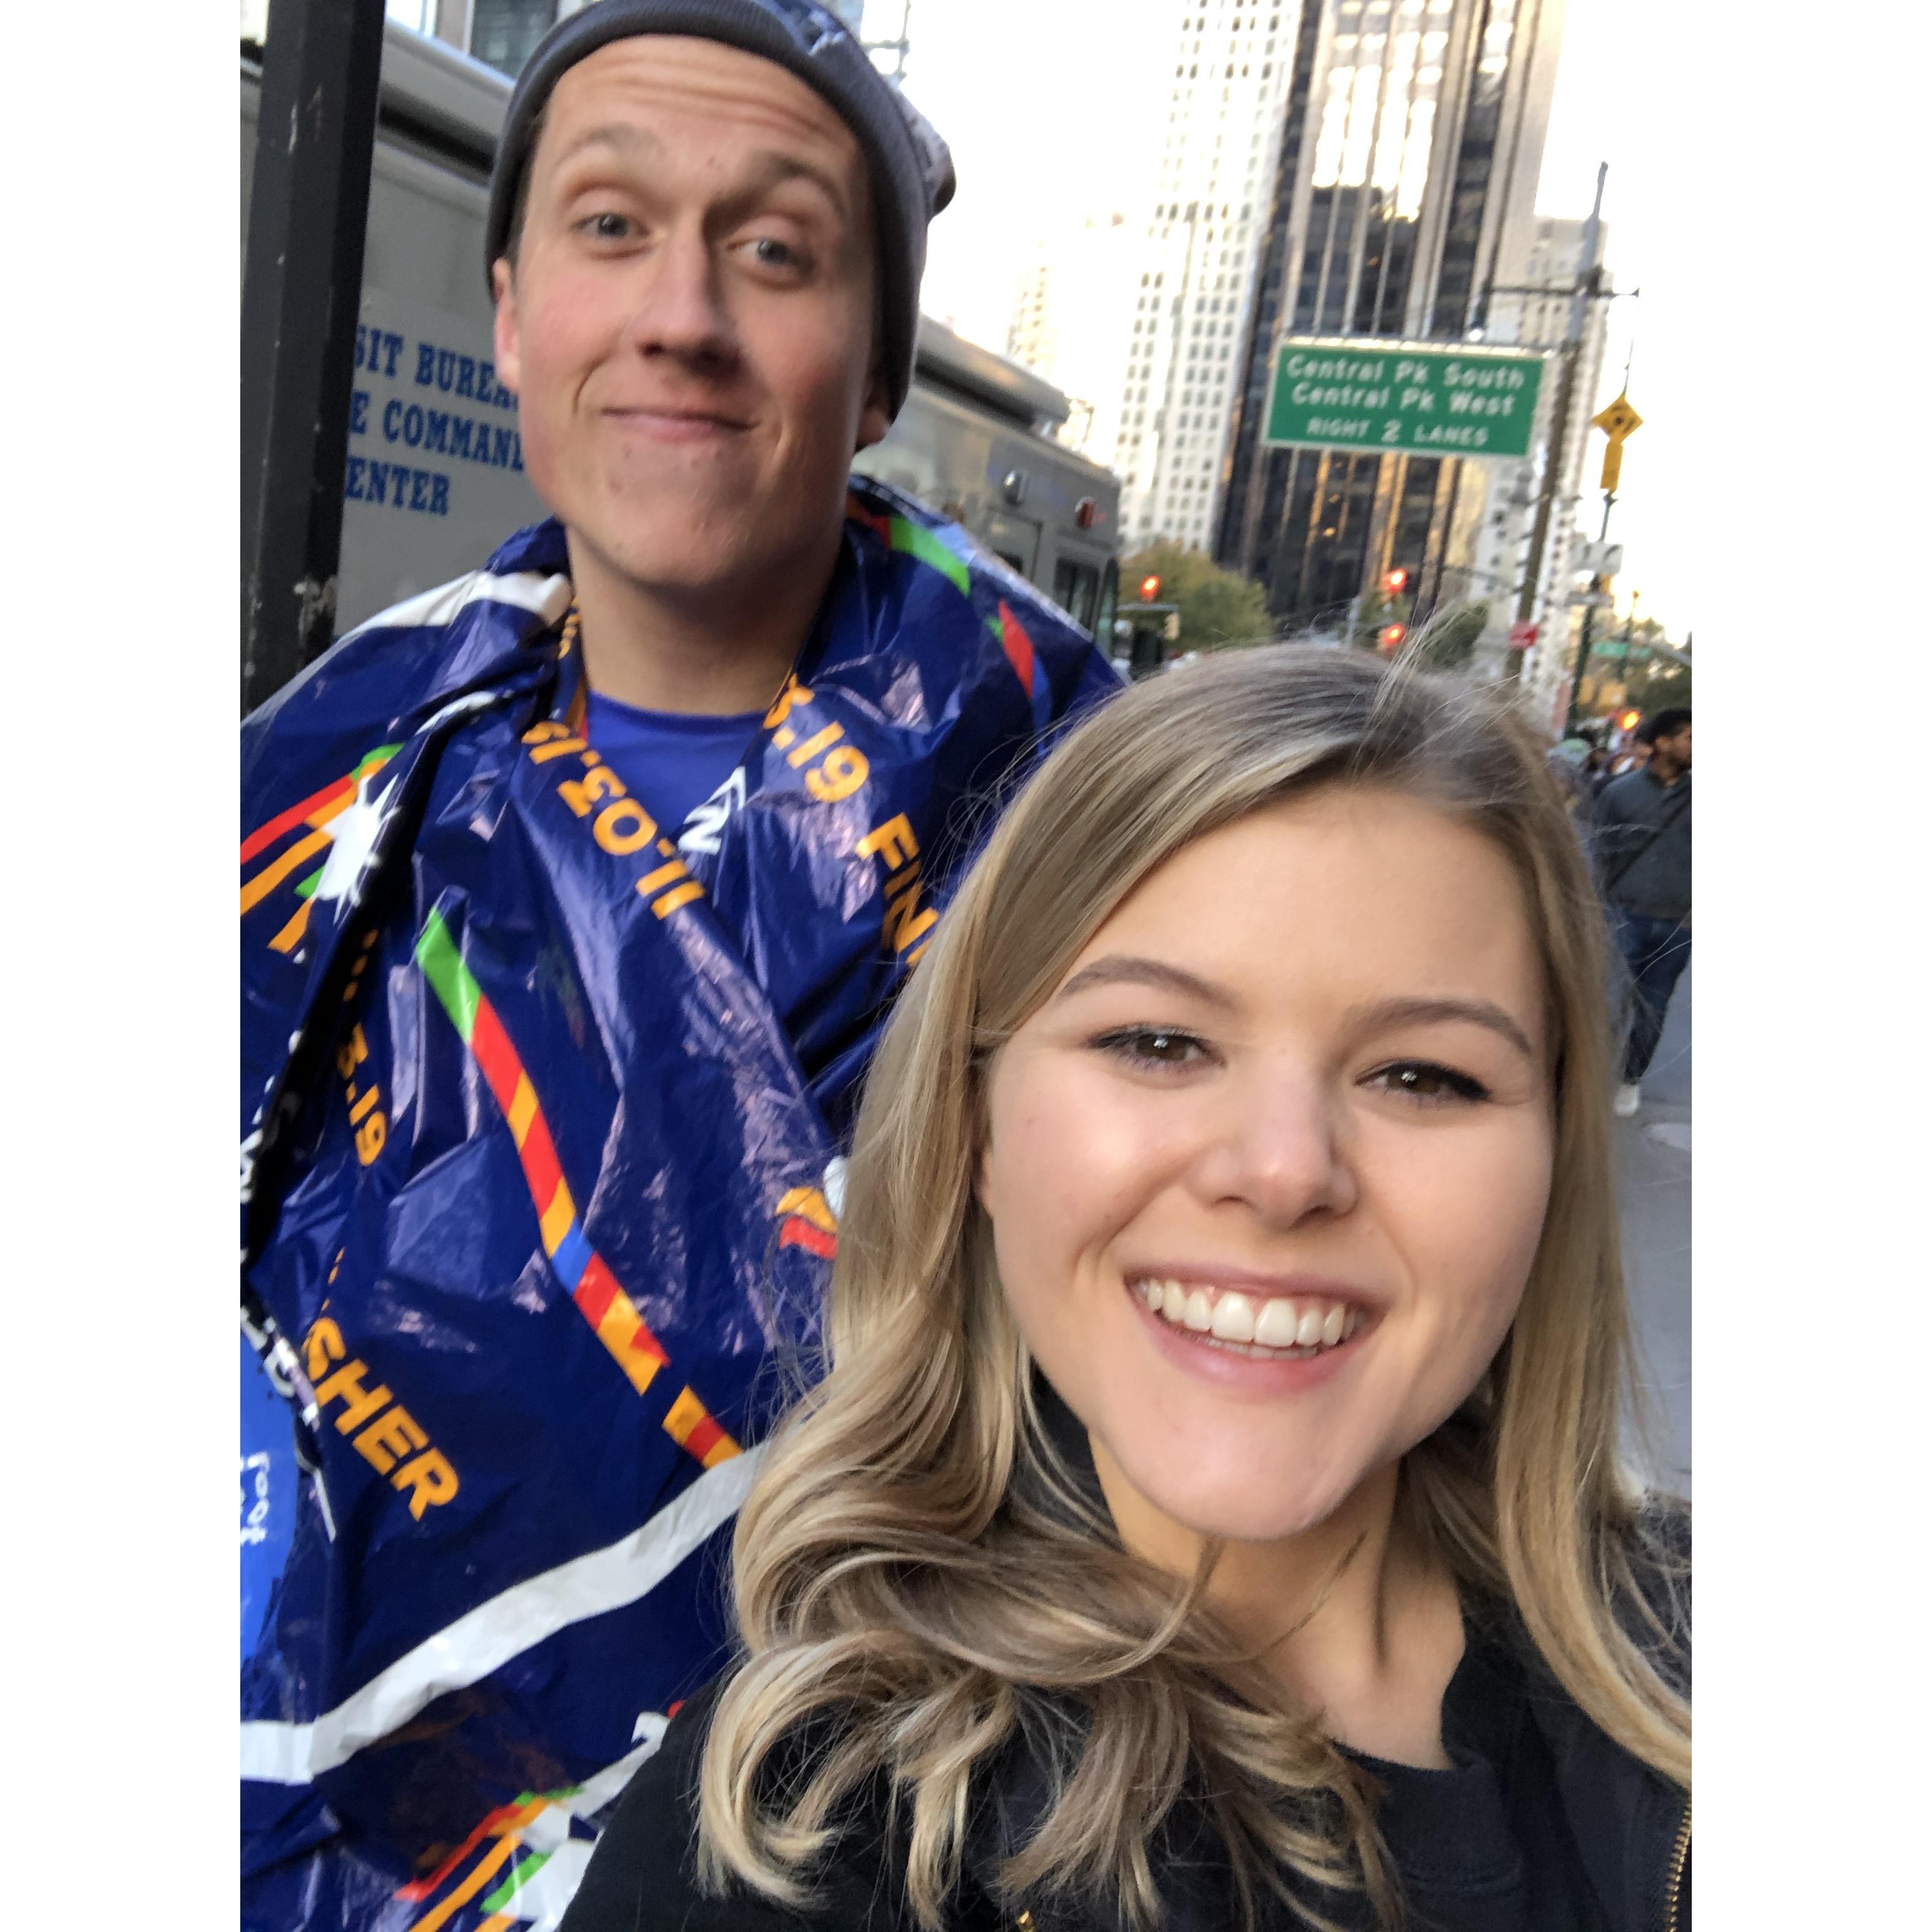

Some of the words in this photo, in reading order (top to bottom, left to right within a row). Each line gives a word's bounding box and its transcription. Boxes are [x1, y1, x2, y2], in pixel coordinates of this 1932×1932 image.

[414, 342, 519, 413] BUREA
[1287, 353, 1385, 382] Central
[1394, 360, 1430, 385] Pk
[1443, 362, 1525, 389] South
[1291, 382, 1391, 410] Central
[1400, 387, 1436, 413] Pk
[1449, 392, 1516, 417] West
[1306, 417, 1370, 439] RIGHT
[1381, 420, 1401, 443] 2
[1413, 424, 1489, 447] LANES
